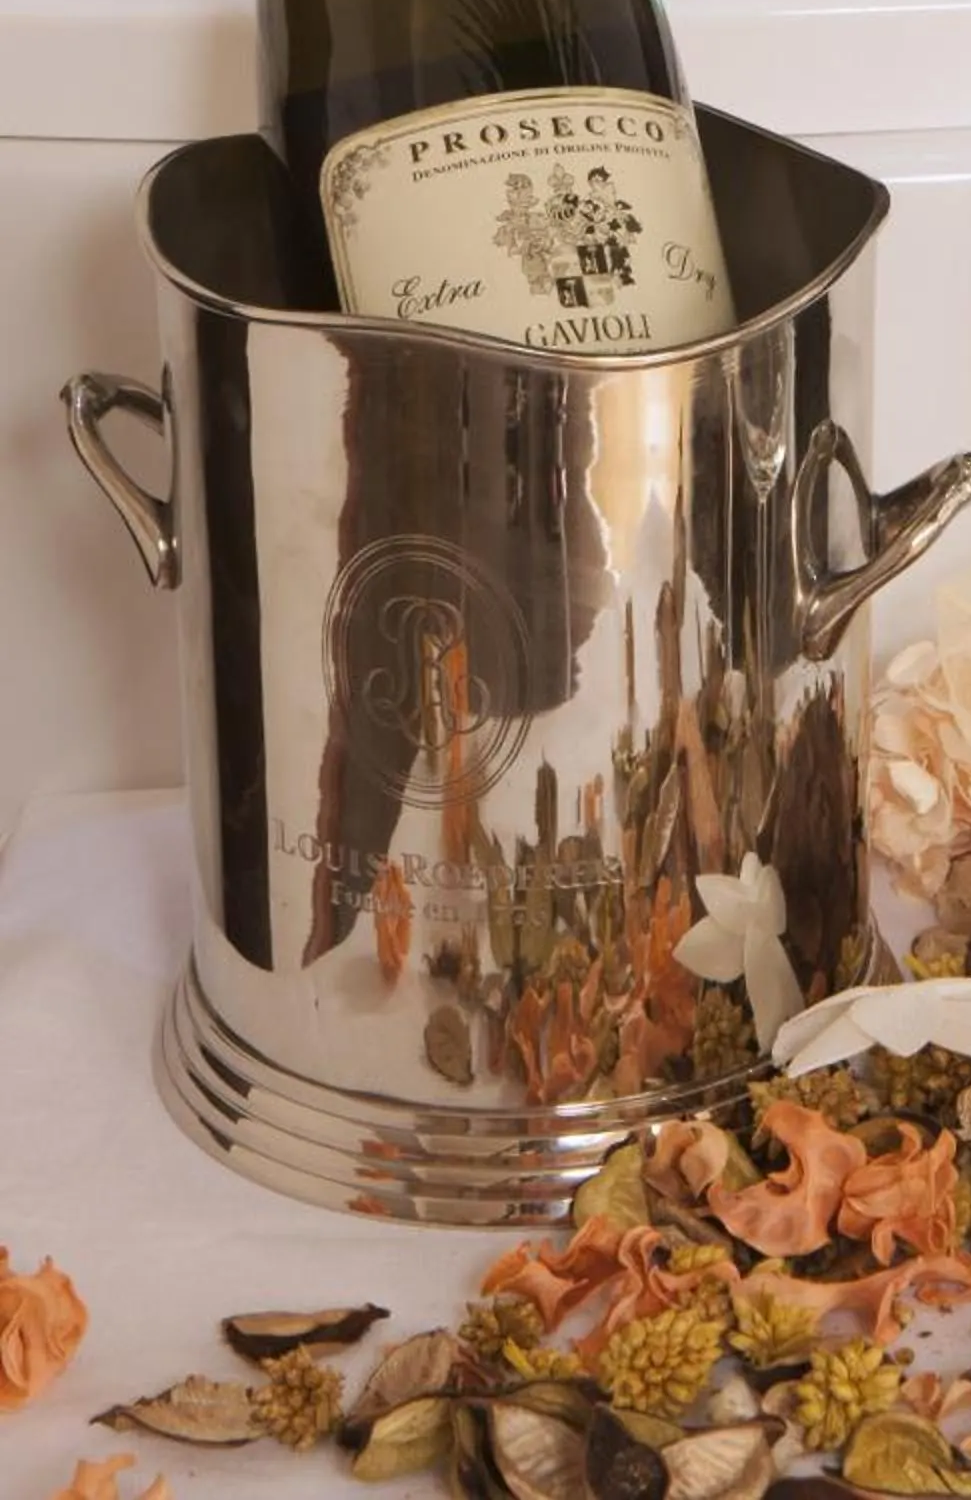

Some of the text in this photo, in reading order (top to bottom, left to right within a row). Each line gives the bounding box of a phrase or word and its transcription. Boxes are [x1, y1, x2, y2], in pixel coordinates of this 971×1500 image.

[408, 114, 665, 163] PROSECCO
[391, 240, 716, 319] Extra Dry
[524, 312, 652, 348] GAVIOLI
